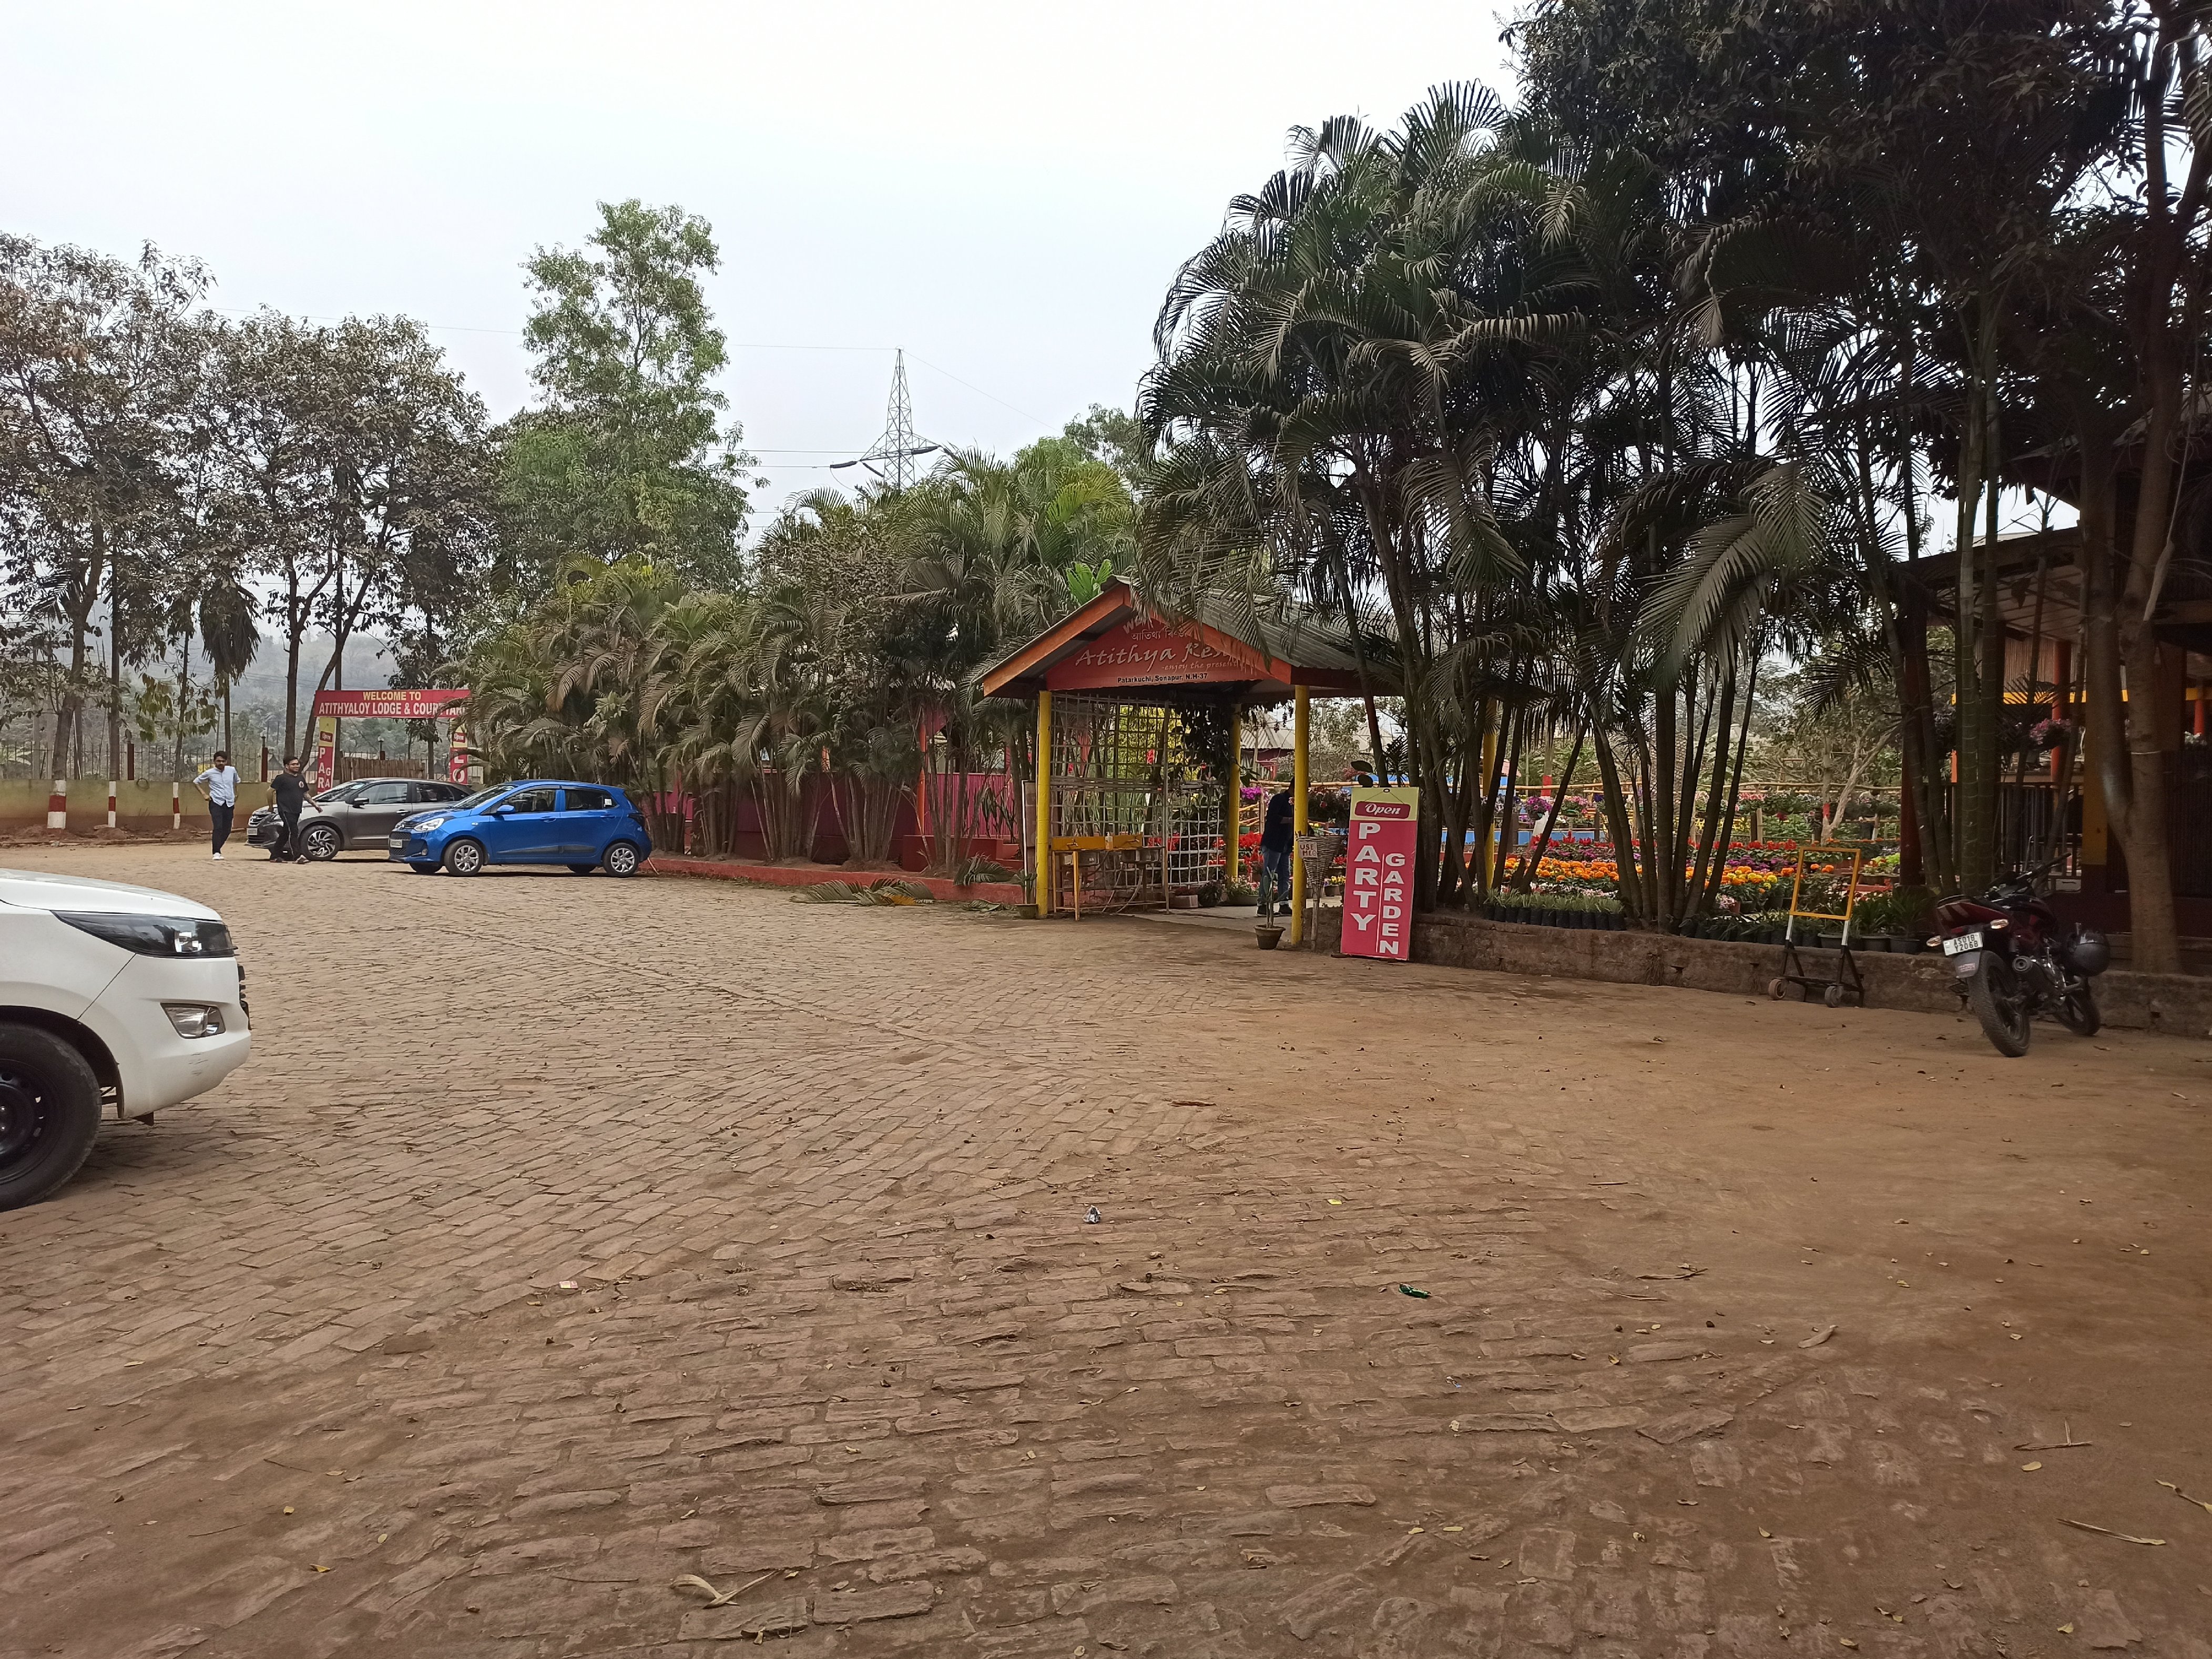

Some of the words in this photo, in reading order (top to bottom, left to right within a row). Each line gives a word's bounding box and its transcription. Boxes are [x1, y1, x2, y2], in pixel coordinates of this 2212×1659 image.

[1075, 644, 1176, 672] Atithya
[363, 691, 406, 700] WELCOME
[410, 691, 421, 700] TO
[319, 703, 370, 714] ATITHYALOY
[372, 703, 402, 714] LODGE
[404, 703, 411, 715] &
[1365, 803, 1401, 816] Open
[1350, 822, 1381, 931] PARTY
[1379, 853, 1405, 955] GARDEN
